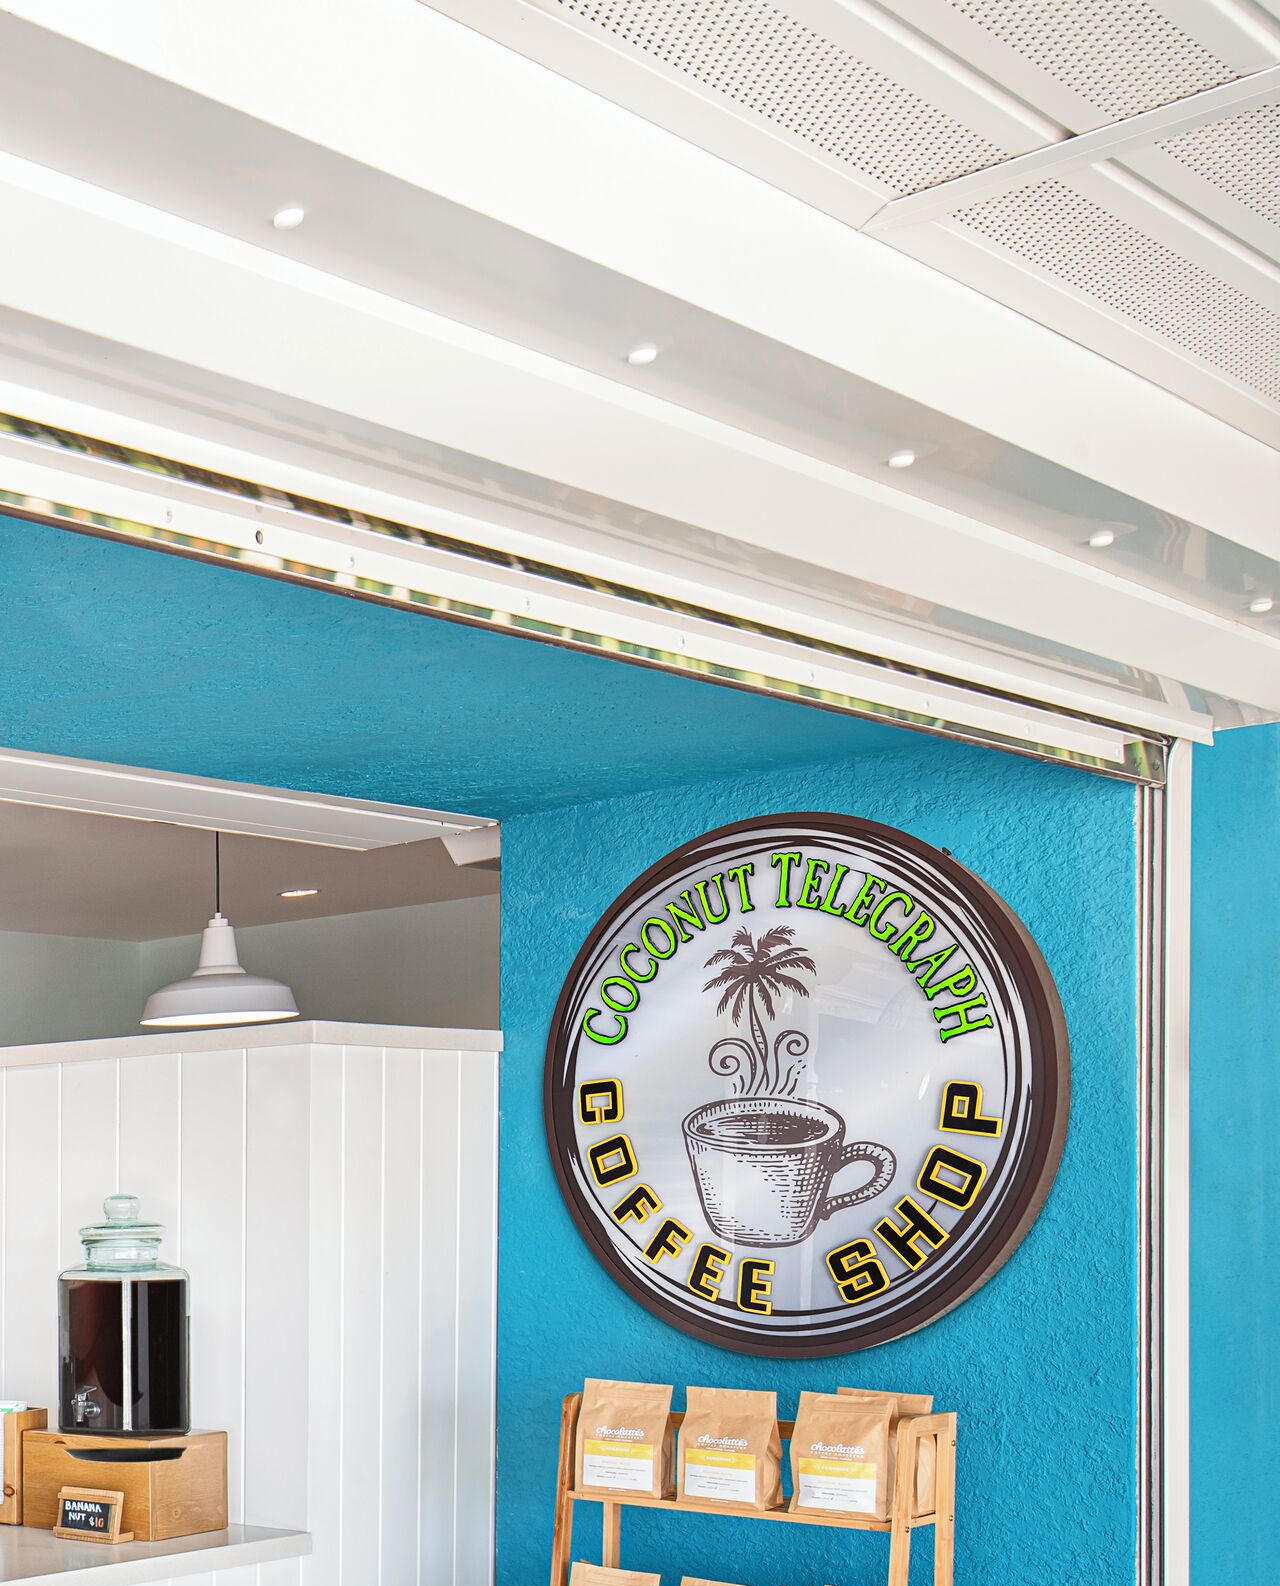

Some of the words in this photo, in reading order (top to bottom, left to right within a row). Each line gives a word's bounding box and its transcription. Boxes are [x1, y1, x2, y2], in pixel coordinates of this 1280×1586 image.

[582, 863, 754, 1046] COCONUT
[771, 851, 993, 1044] TELEGRAPH
[580, 1078, 775, 1316] COFFEE
[824, 1080, 1002, 1304] SHOP
[65, 1501, 102, 1512] BANANA
[69, 1512, 86, 1520] NUT
